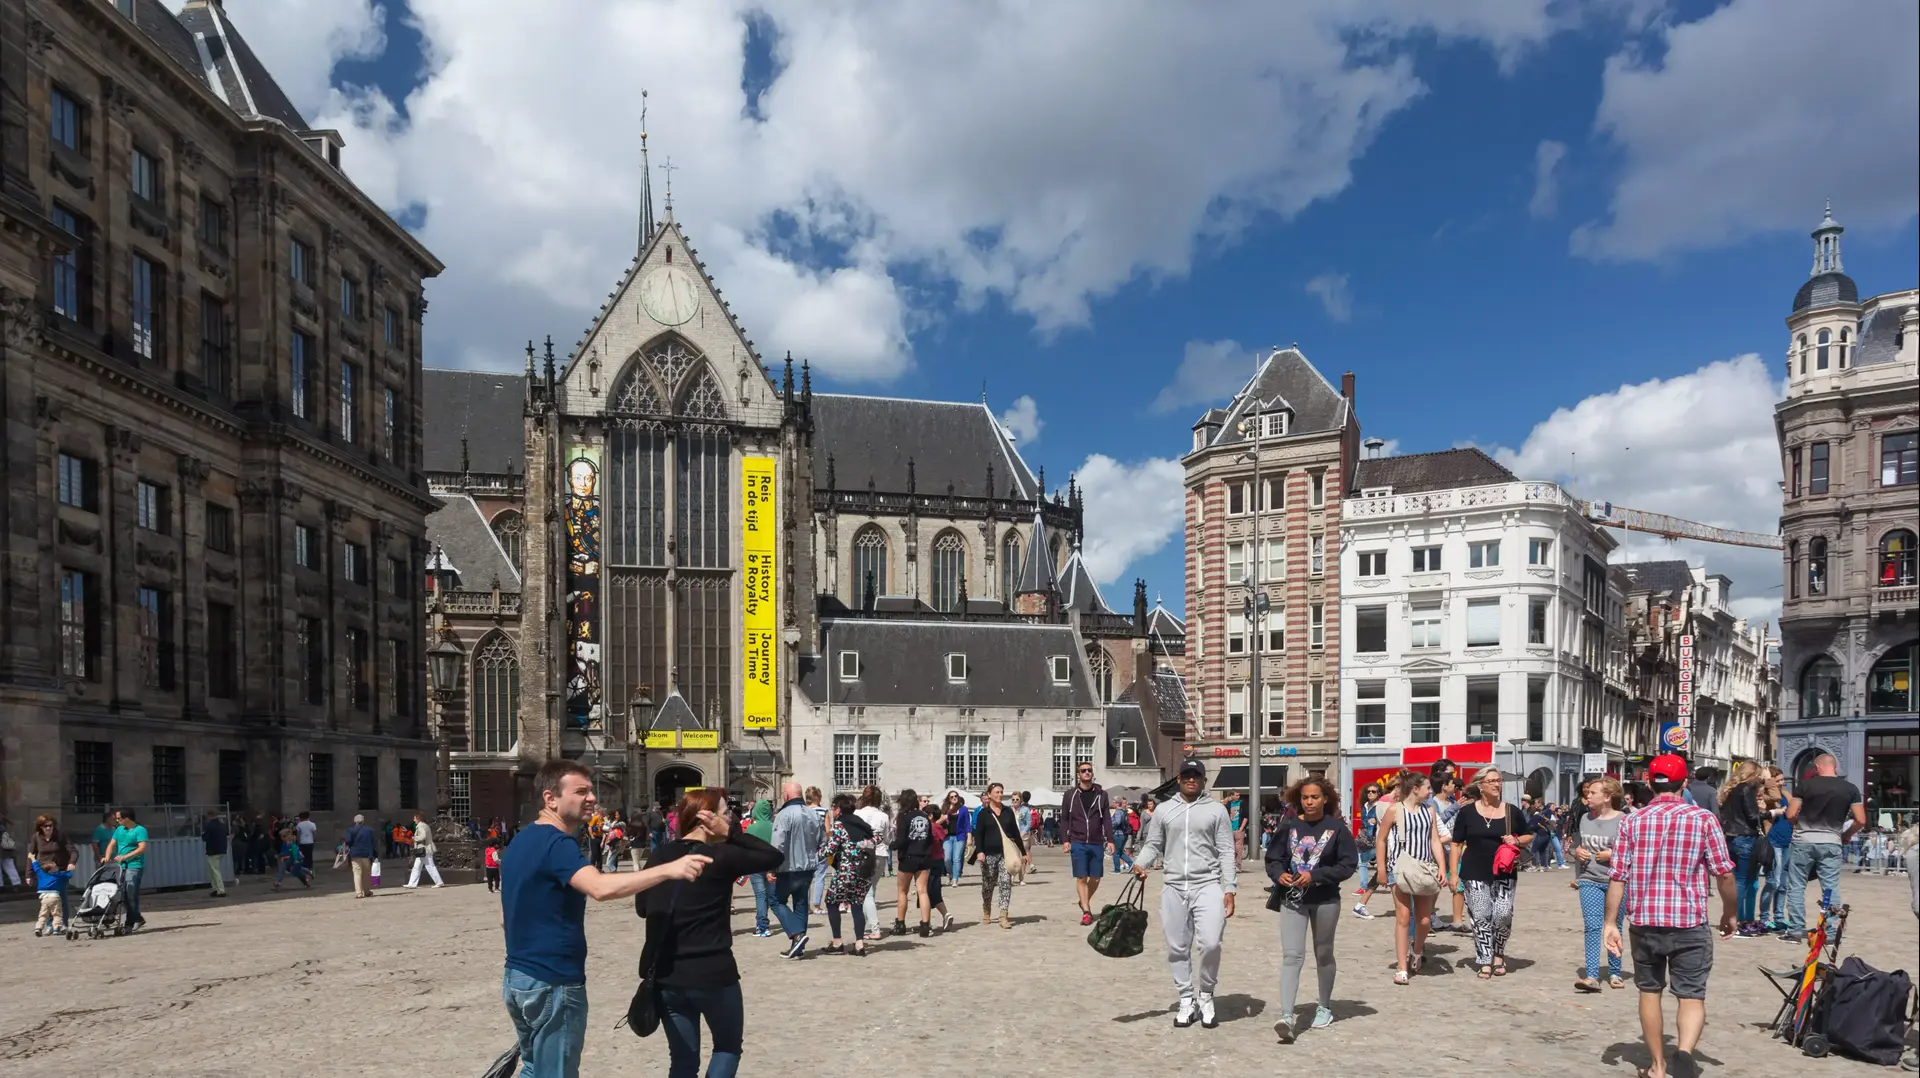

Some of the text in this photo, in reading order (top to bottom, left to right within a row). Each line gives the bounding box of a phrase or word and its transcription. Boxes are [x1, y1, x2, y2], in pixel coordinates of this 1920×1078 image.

[746, 475, 758, 531] in de tijd
[761, 476, 771, 502] Reis
[746, 554, 758, 616] & Royalty
[759, 555, 771, 602] History
[748, 633, 758, 679] in Time
[760, 632, 772, 686] Journey
[748, 715, 772, 724] Open
[1243, 746, 1276, 756] God
